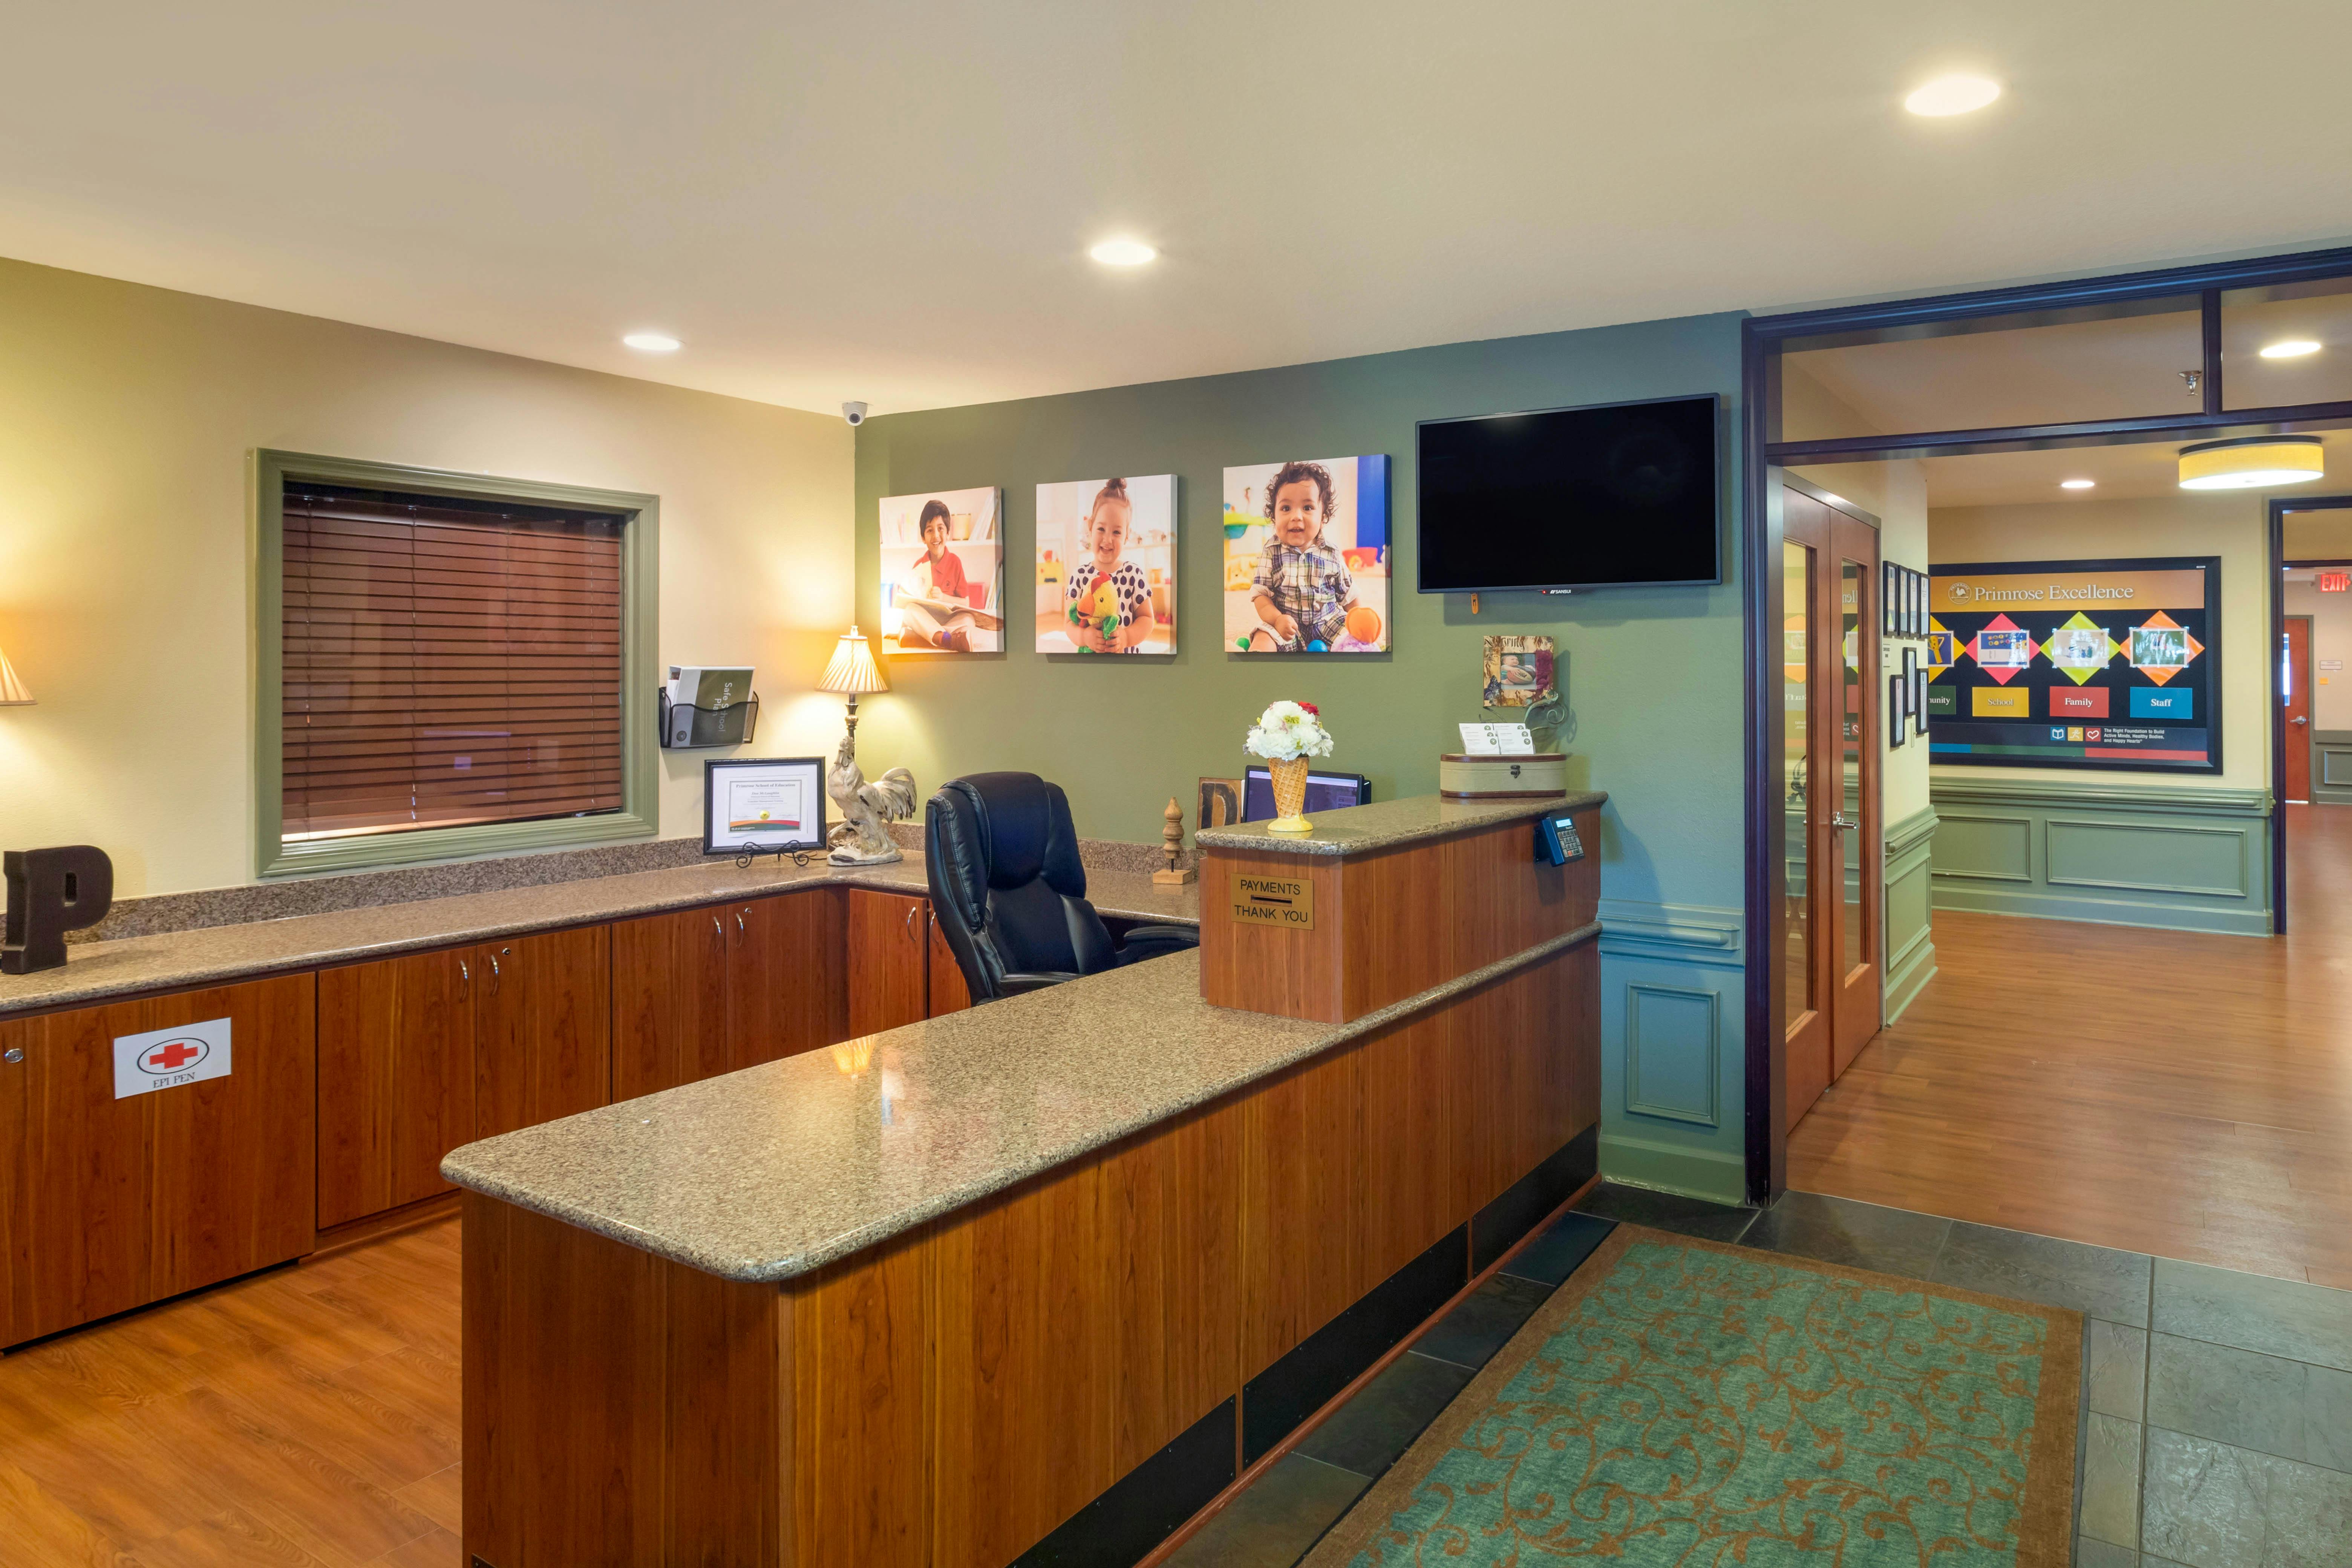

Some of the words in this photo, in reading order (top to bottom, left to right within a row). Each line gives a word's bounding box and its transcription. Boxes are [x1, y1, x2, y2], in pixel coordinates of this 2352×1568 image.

[2321, 574, 2347, 592] EXIT
[1974, 586, 2044, 601] Primrose
[2049, 584, 2134, 600] Excellence
[723, 682, 732, 701] Safe
[1929, 696, 1951, 705] unity
[1988, 698, 2014, 706] School
[2065, 698, 2093, 707] Family
[2151, 698, 2173, 707] Staff
[1240, 879, 1300, 895] PAYMENTS
[2, 845, 114, 974] P
[1234, 905, 1277, 920] THANK
[1282, 910, 1308, 923] YOU
[153, 1078, 170, 1088] EPI
[174, 1072, 196, 1084] PEN
